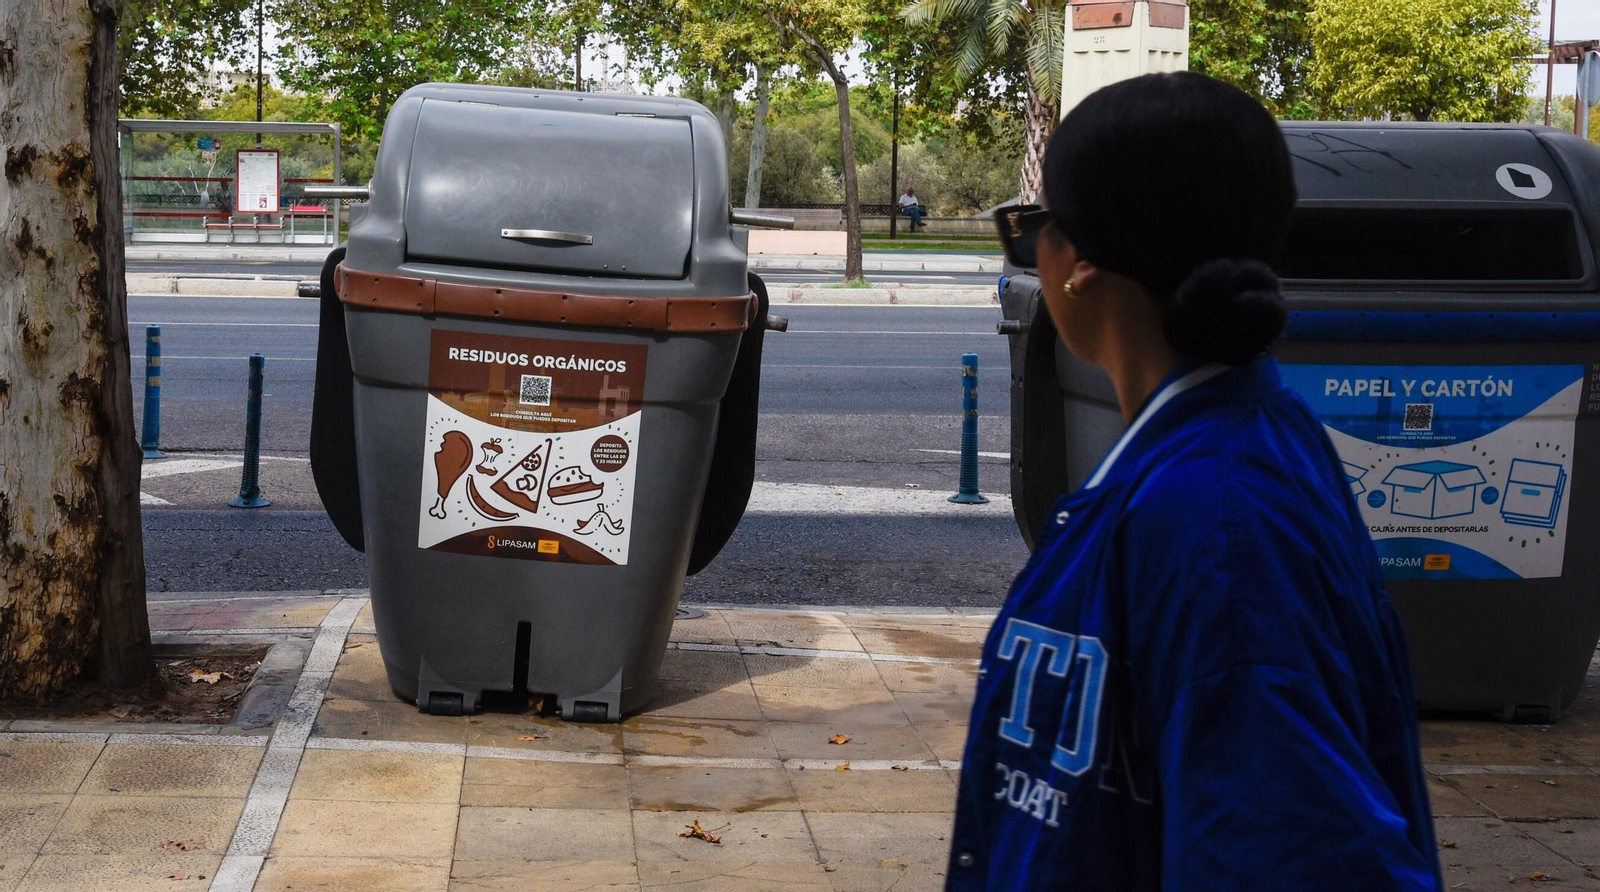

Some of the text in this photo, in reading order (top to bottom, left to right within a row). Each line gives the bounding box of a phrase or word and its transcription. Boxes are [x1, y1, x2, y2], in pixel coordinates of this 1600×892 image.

[449, 347, 627, 373] RESIDUOS ORGÁNICOS
[1324, 375, 1513, 397] PAPEL Y CARTÓN
[1370, 525, 1395, 533] CAJAS
[1433, 525, 1489, 533] DEPOSITARLAS
[496, 539, 536, 549] LIPASAM
